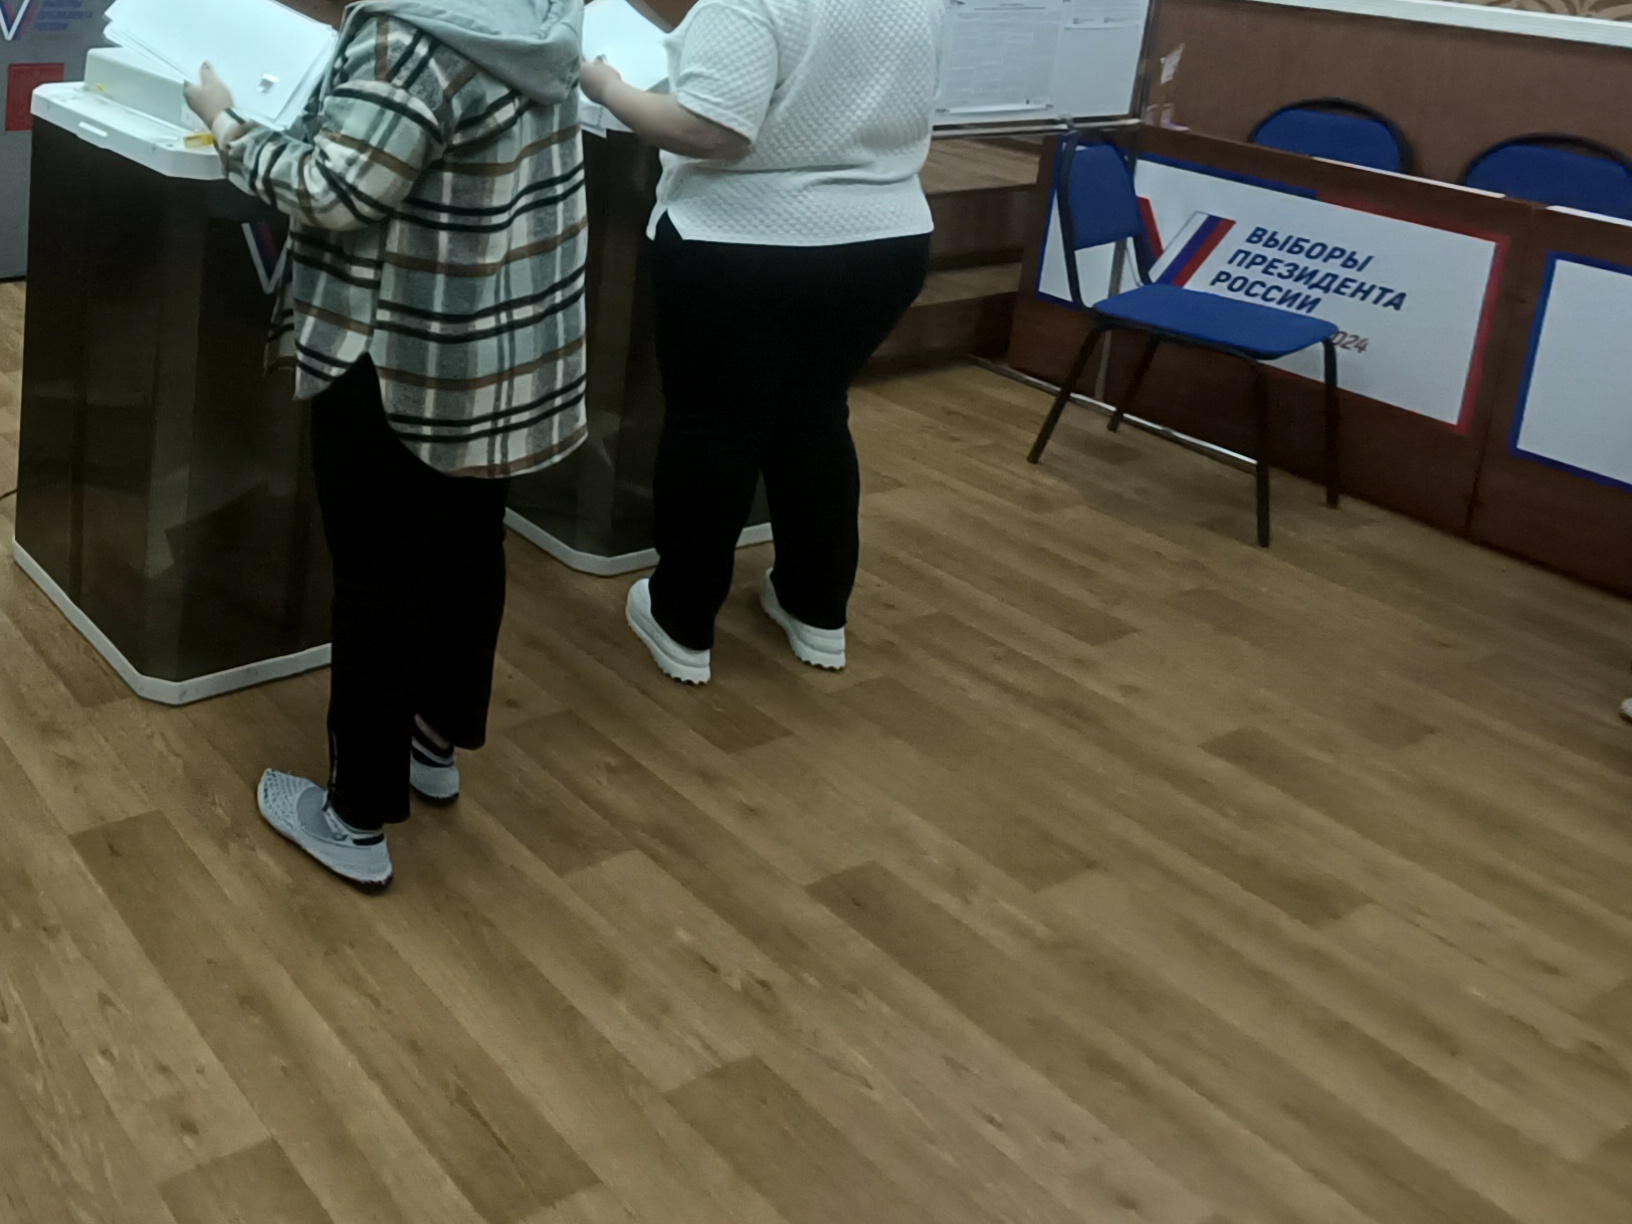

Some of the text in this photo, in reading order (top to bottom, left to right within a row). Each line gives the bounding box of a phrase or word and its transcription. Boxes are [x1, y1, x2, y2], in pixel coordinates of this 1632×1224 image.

[1244, 226, 1375, 273] ВЫБОРЫ
[1209, 269, 1322, 314] РОССИИ
[1227, 248, 1408, 312] ПРЕЗИДЕНТА
[1331, 329, 1370, 354] 024
